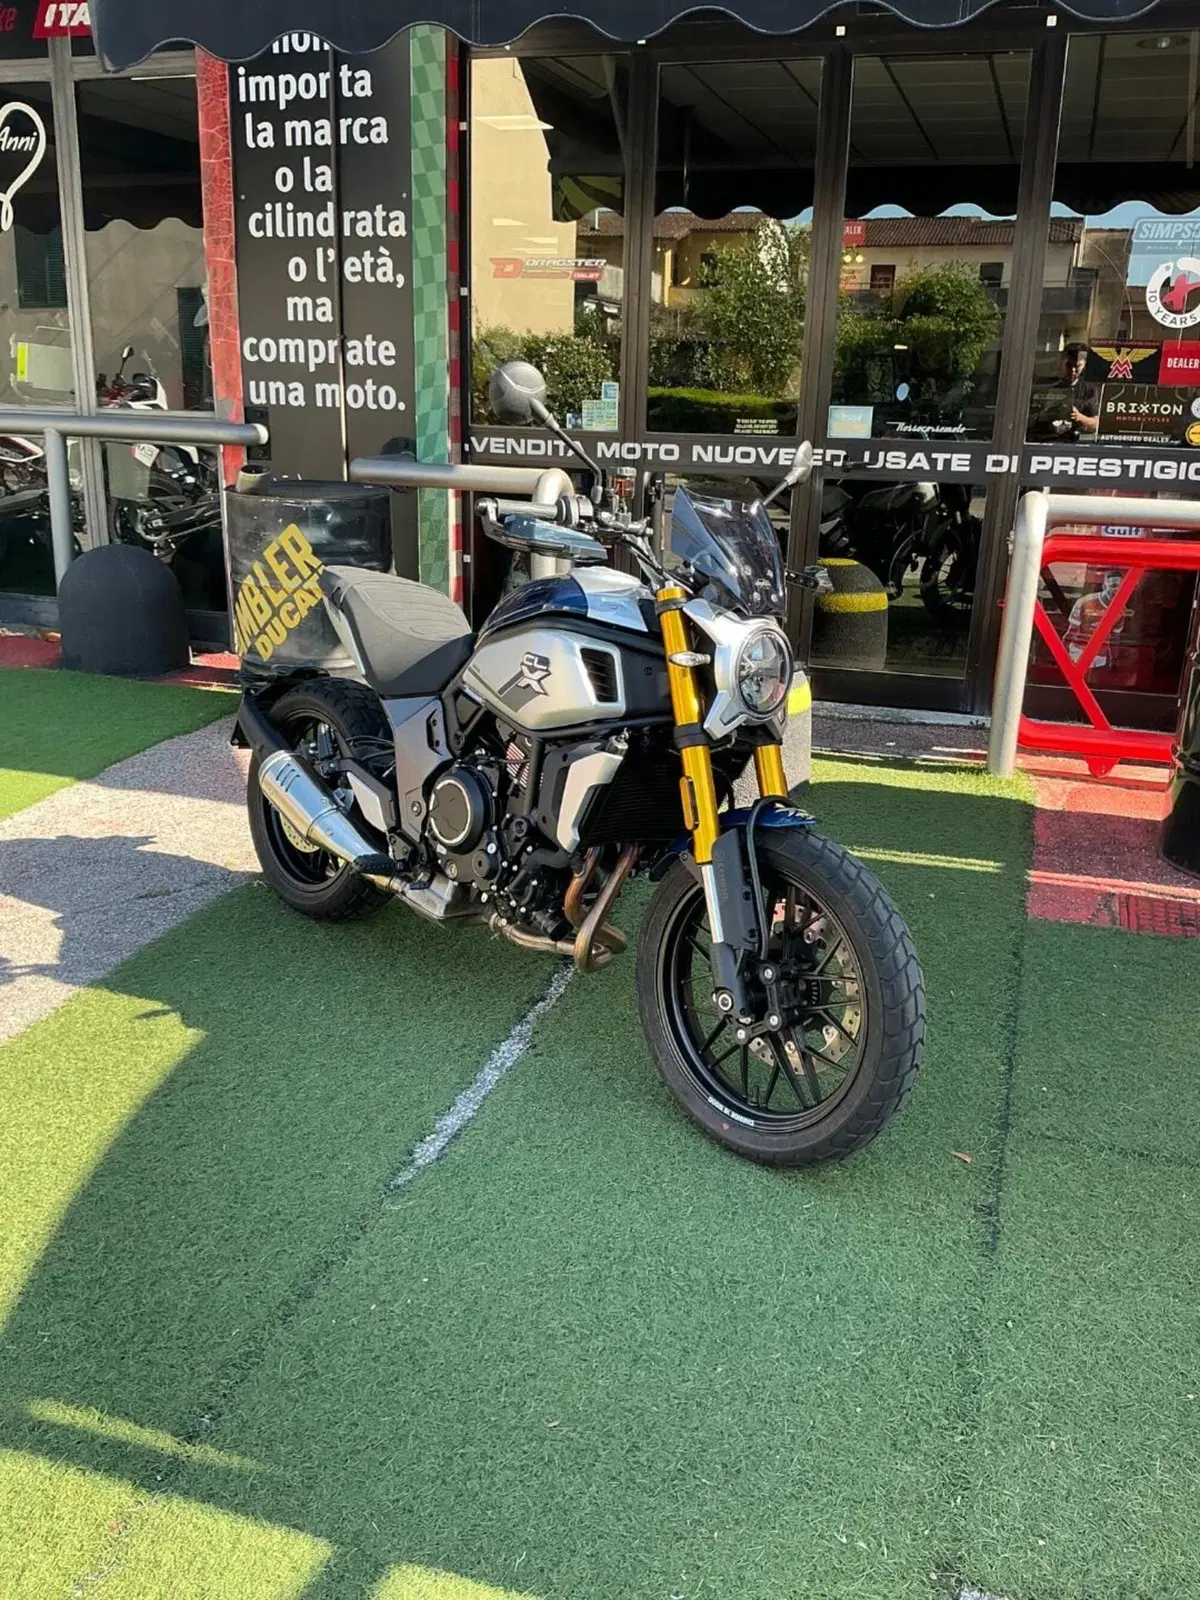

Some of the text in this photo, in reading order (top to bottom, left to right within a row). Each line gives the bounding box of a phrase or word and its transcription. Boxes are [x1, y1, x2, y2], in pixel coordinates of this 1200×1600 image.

[237, 64, 373, 110] importa
[245, 112, 389, 148] la marca
[275, 156, 333, 193] o la
[248, 201, 407, 238] cilindrata
[288, 256, 307, 282] o
[525, 258, 606, 268] DRAGSTER
[286, 296, 333, 322] ma
[1148, 290, 1198, 326] 10 YEARS
[243, 334, 396, 372] comprate
[1167, 358, 1200, 369] DEALER
[249, 378, 406, 411] una moto.
[470, 436, 585, 457] VENDITA
[597, 441, 680, 462] MOTO
[691, 445, 797, 466] NUOVE
[863, 450, 971, 472] USATE
[985, 455, 1018, 474] DI
[1100, 434, 1142, 442] AUTHORIZED
